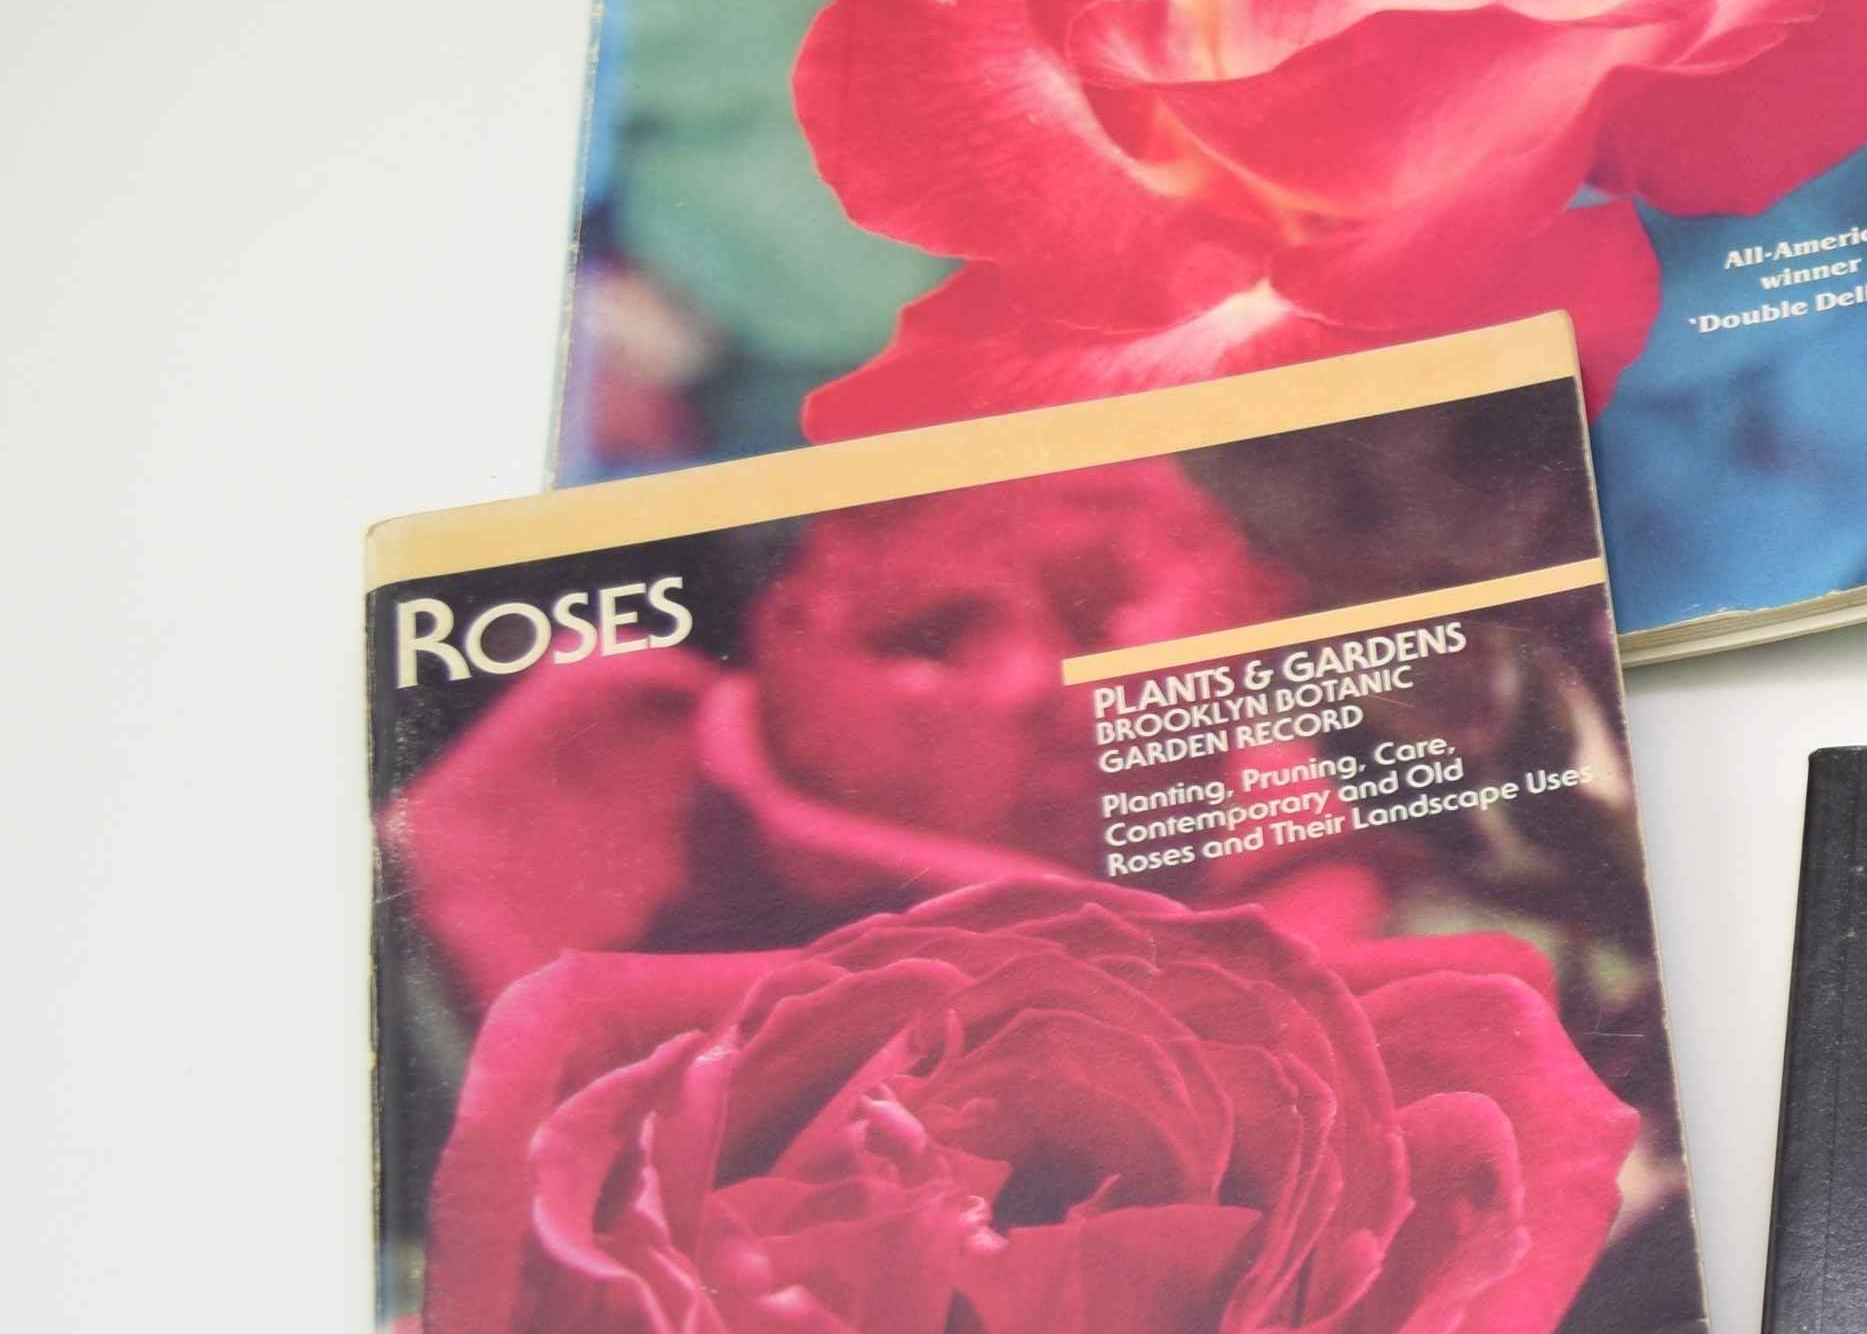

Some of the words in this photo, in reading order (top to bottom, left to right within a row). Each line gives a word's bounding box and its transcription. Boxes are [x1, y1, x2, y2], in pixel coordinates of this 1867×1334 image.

[1760, 258, 1862, 291] winner
[1689, 300, 1808, 333] 'Double
[395, 577, 692, 688] ROSES
[1094, 667, 1234, 718] PLANTS
[1243, 660, 1274, 691] &
[1282, 622, 1468, 683] GARDENS
[1096, 691, 1268, 747] BROOKLYN
[1276, 666, 1413, 712] BOTANIC
[1098, 730, 1228, 775] GARDEN
[1236, 705, 1364, 750] RECORD
[1102, 778, 1234, 819] Planting,
[1242, 752, 1366, 795] Pruning,
[1374, 736, 1457, 768] Care,
[1105, 789, 1329, 849] Contemporary
[1339, 772, 1399, 803] and
[1406, 758, 1463, 788] Old
[1107, 844, 1196, 878] Roses
[1202, 829, 1264, 861] and
[1270, 815, 1347, 848] Their
[1351, 779, 1519, 831] Landscape
[1525, 765, 1593, 796] Uses
